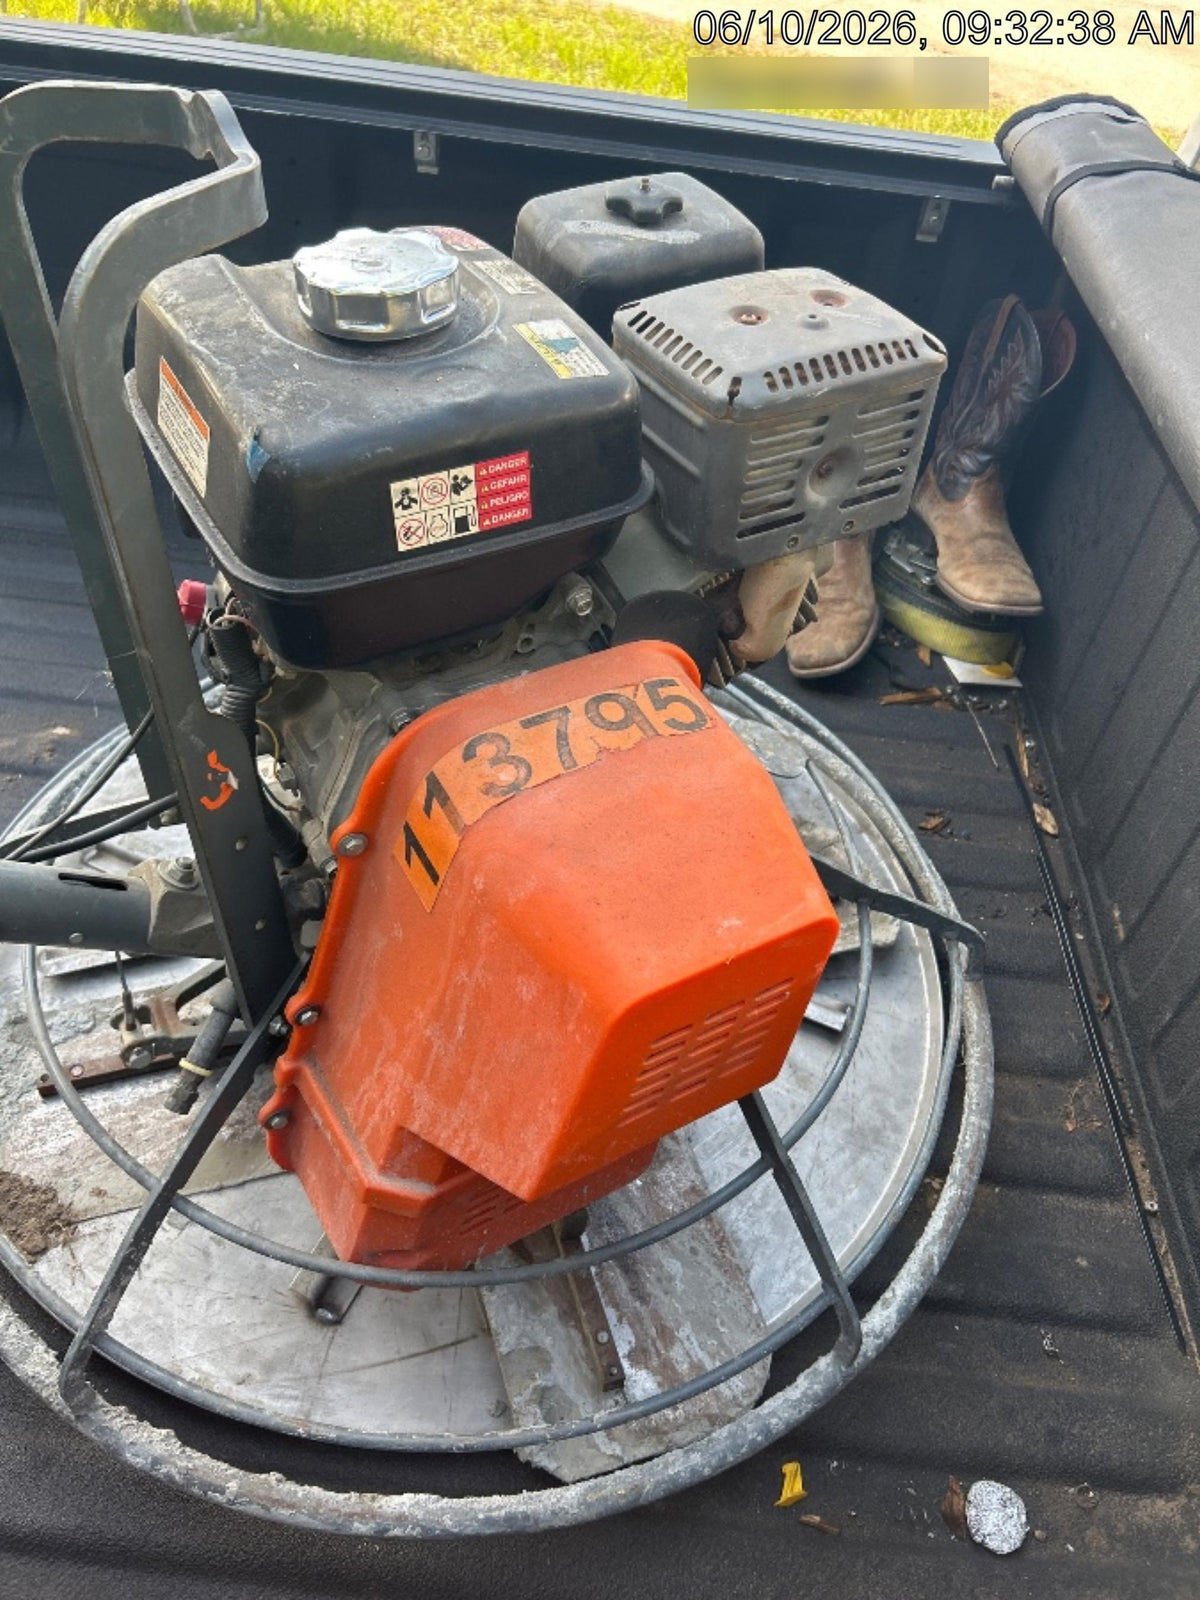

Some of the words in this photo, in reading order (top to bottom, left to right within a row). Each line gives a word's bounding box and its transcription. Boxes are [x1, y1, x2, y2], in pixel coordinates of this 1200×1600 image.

[488, 457, 528, 474] DANGER
[490, 474, 528, 490] GEFAHR
[490, 491, 529, 508] PELIGRO
[491, 508, 529, 524] DANGER
[403, 678, 709, 886] 113795
